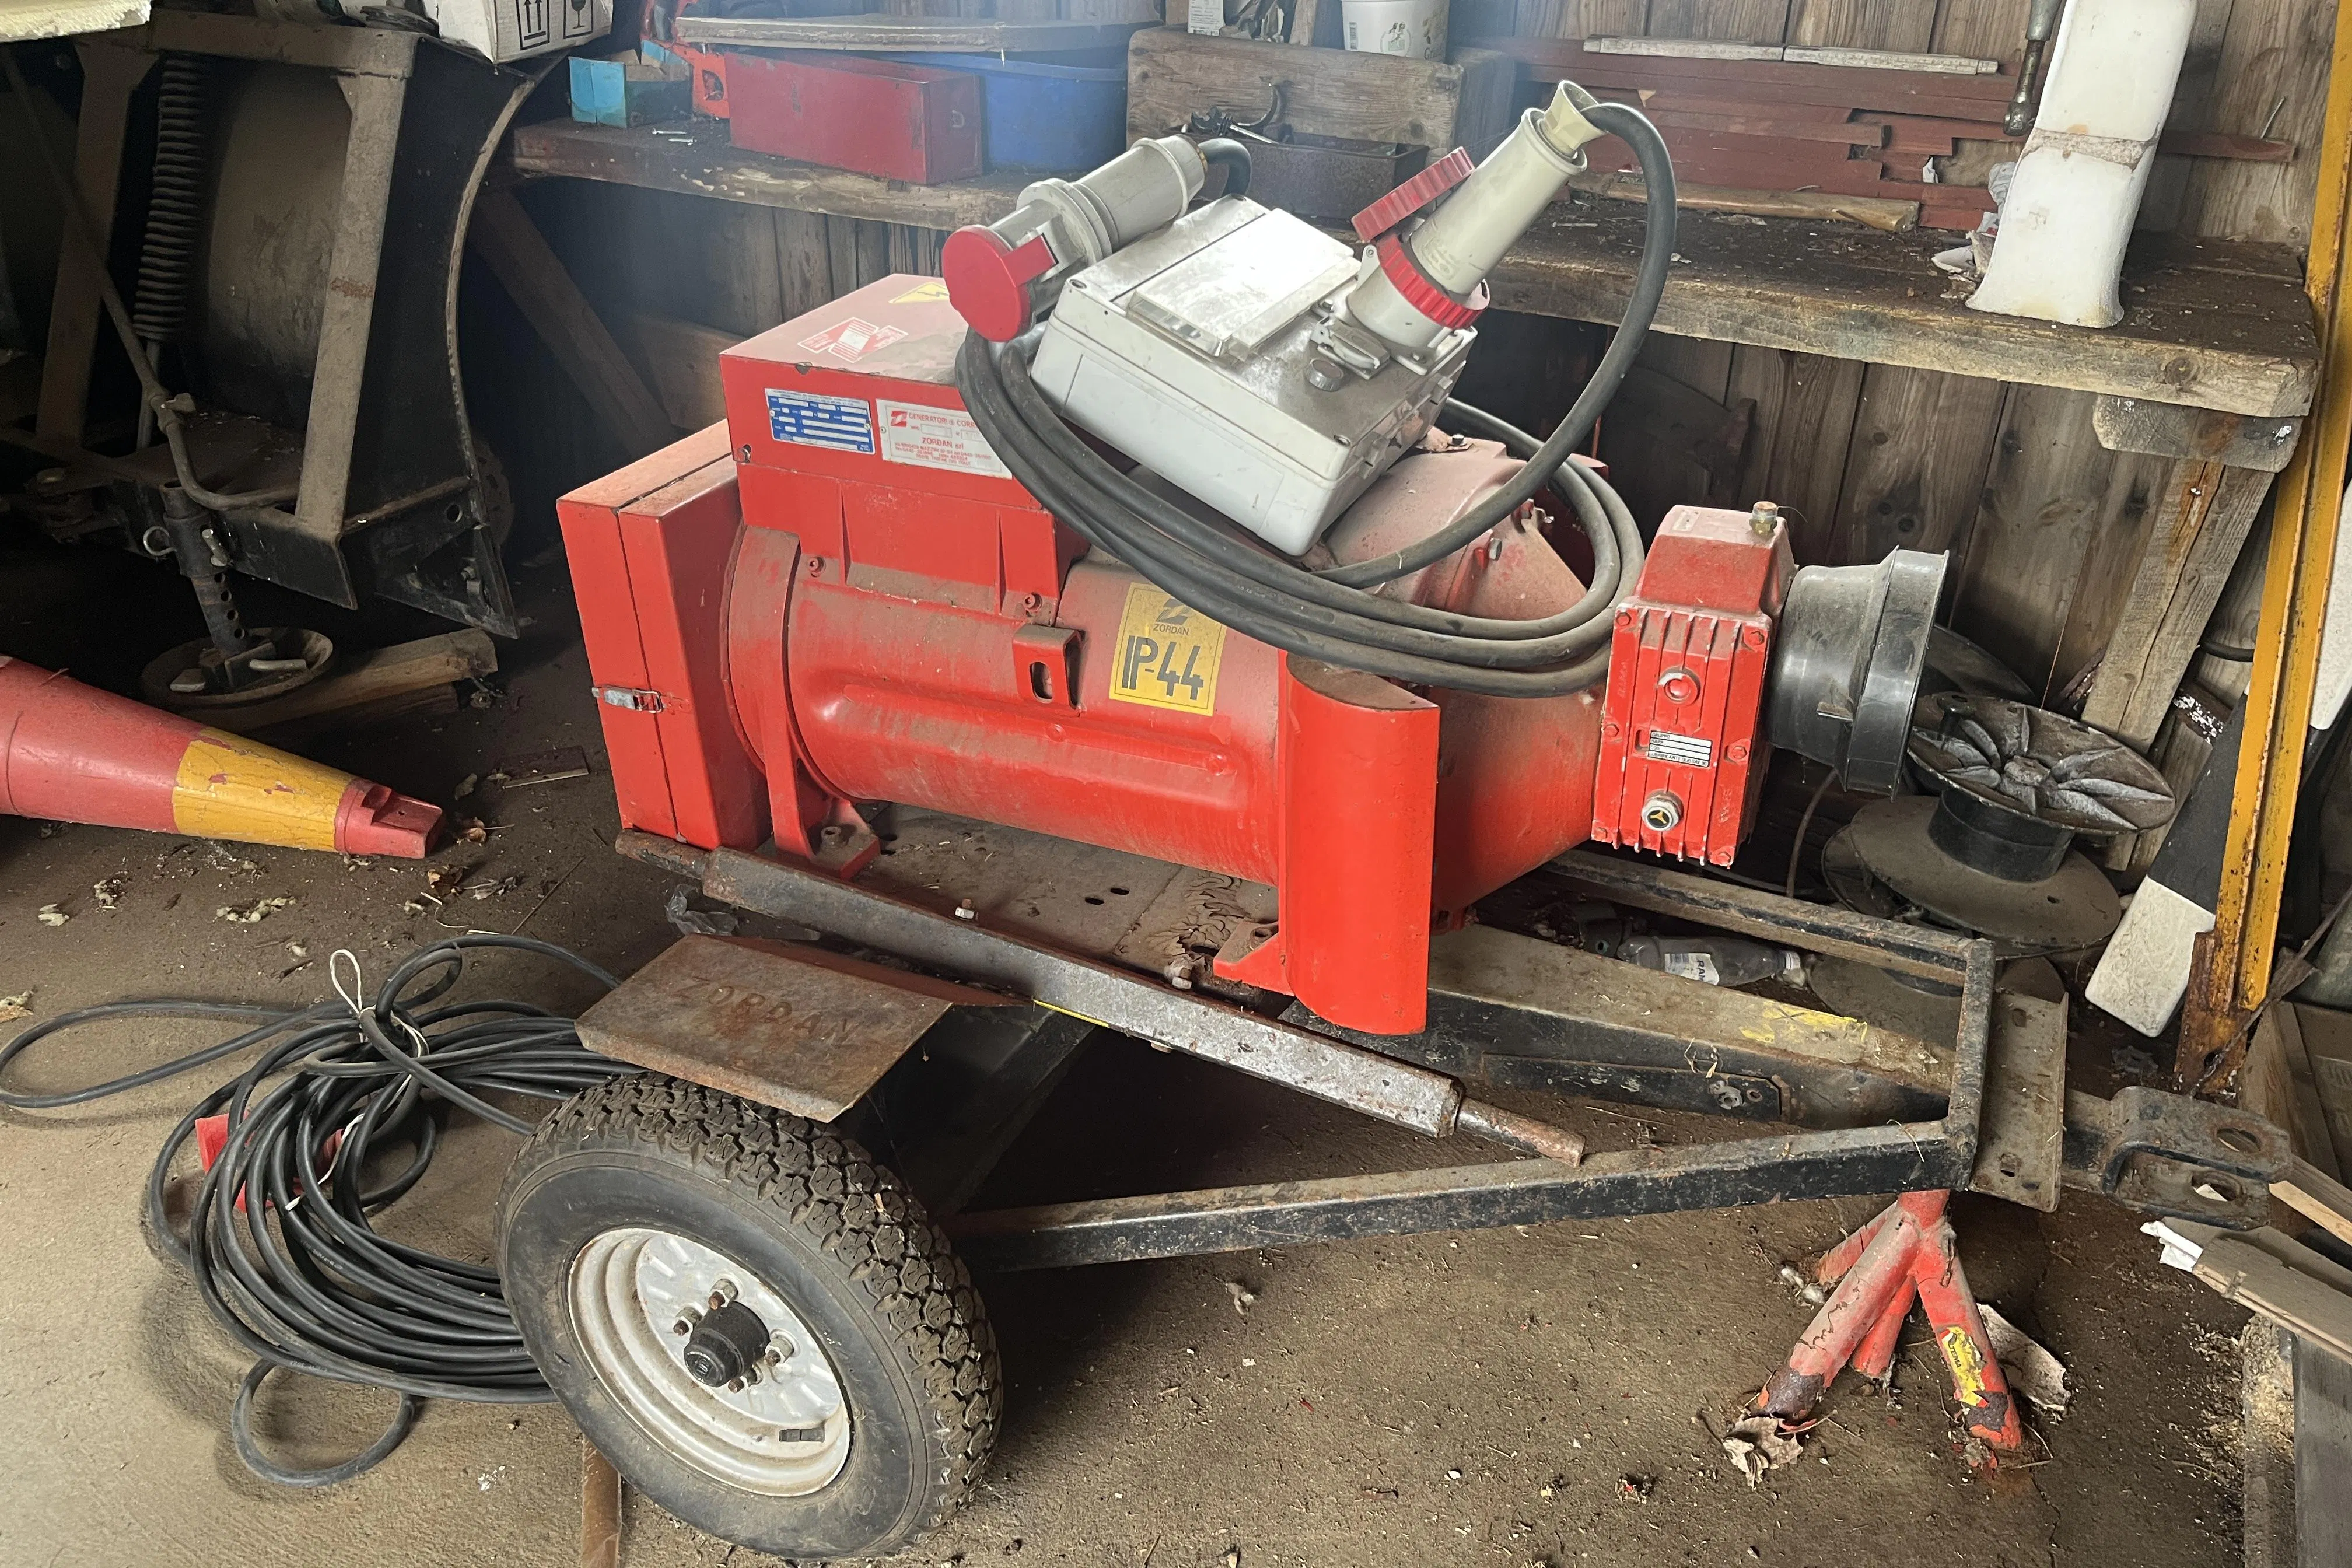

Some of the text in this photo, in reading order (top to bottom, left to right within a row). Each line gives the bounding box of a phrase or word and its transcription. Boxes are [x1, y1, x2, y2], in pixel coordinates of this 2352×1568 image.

[909, 412, 948, 424] GENERATORI
[922, 437, 952, 448] ZORDAN
[1153, 624, 1189, 636] ZORDAN
[1122, 635, 1204, 701] IP-44
